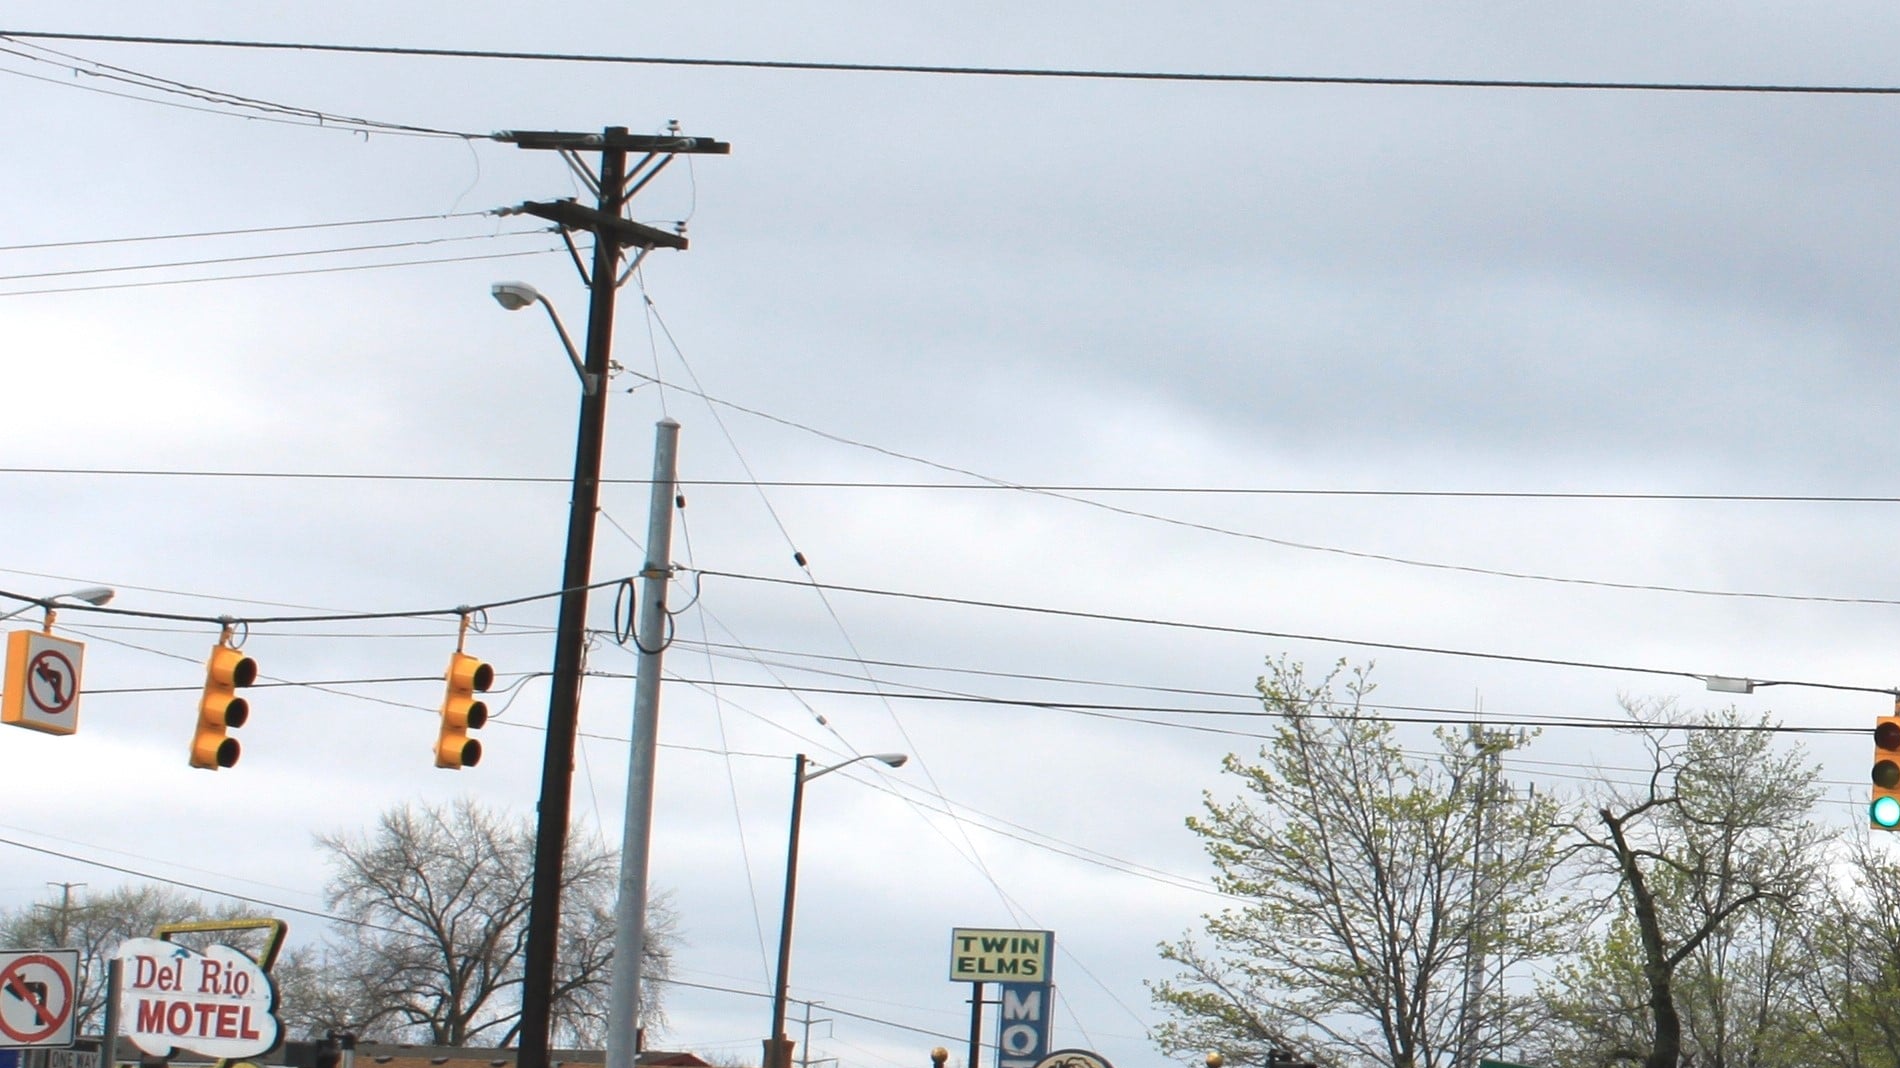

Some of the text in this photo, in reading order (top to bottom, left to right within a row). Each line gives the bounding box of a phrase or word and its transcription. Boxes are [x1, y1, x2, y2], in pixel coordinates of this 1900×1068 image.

[957, 936, 1040, 954] TWIN
[133, 955, 250, 996] Del Rio
[957, 957, 1038, 976] ELMS
[136, 999, 261, 1041] MOTEL
[51, 1051, 74, 1068] ONE
